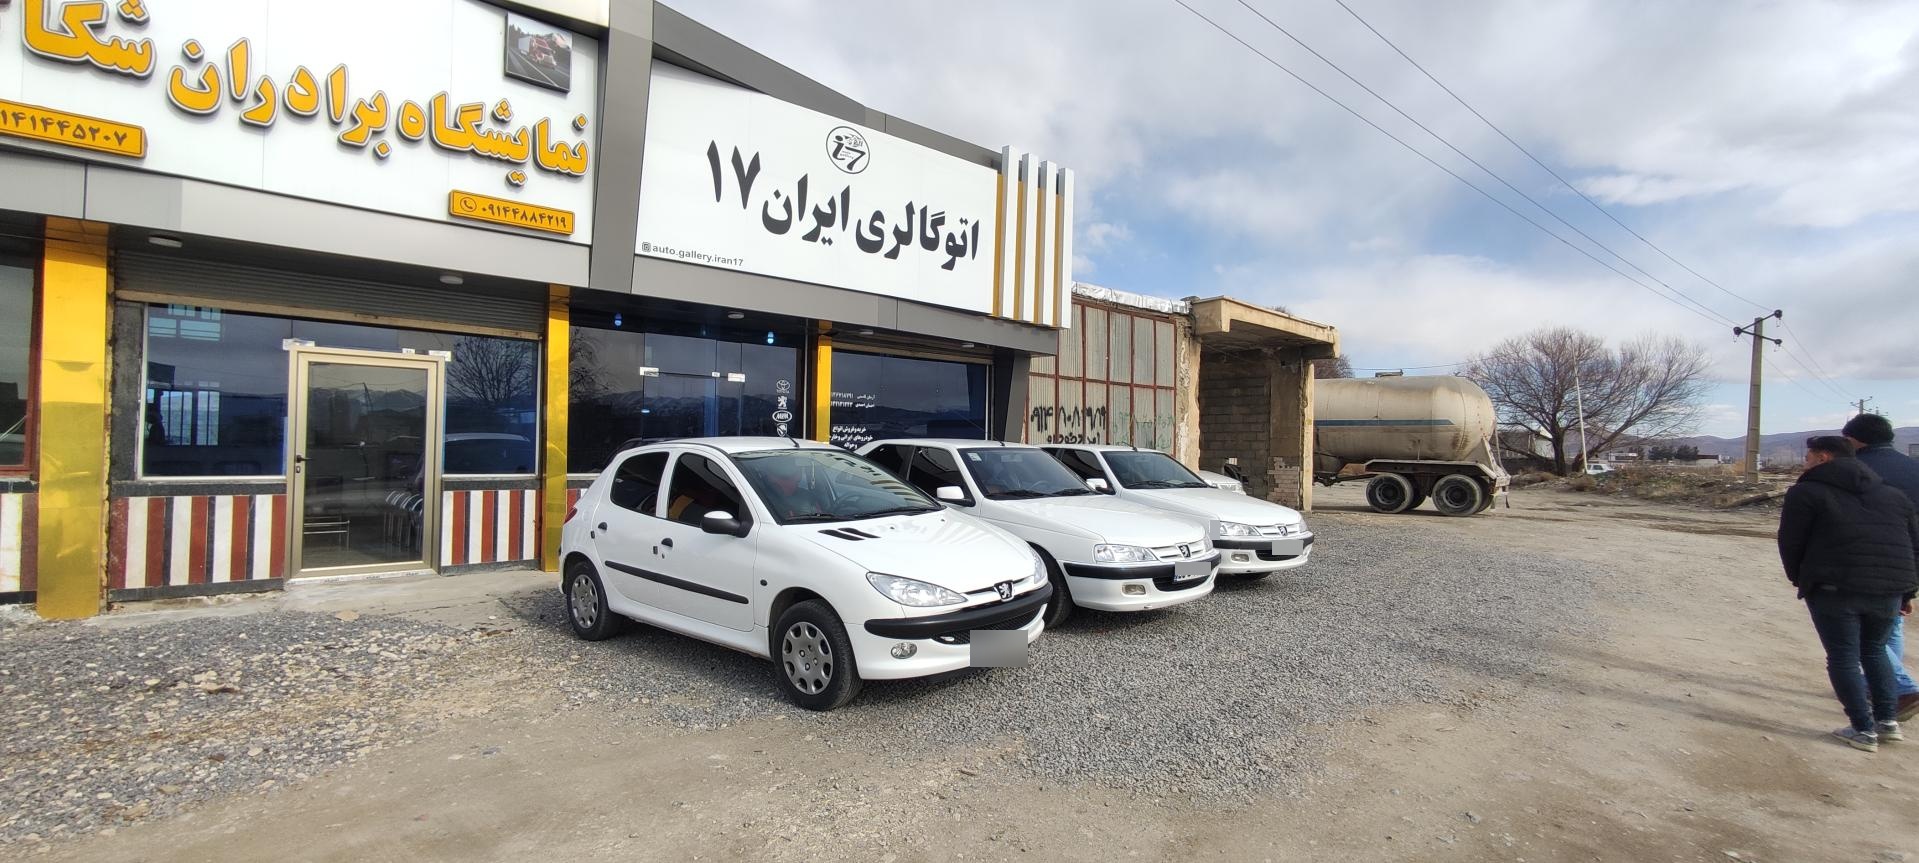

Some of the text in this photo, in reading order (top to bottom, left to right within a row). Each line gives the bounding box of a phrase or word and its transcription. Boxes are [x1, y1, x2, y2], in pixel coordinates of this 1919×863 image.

[0, 0, 590, 186] نمایشگاه برادران شکا
[706, 139, 761, 210] ۱۷
[762, 173, 850, 245] ایران
[482, 203, 566, 228] ۰۹۱۴۴۸۸۴۲۱۹
[652, 245, 744, 266] auto.gallery.iran17
